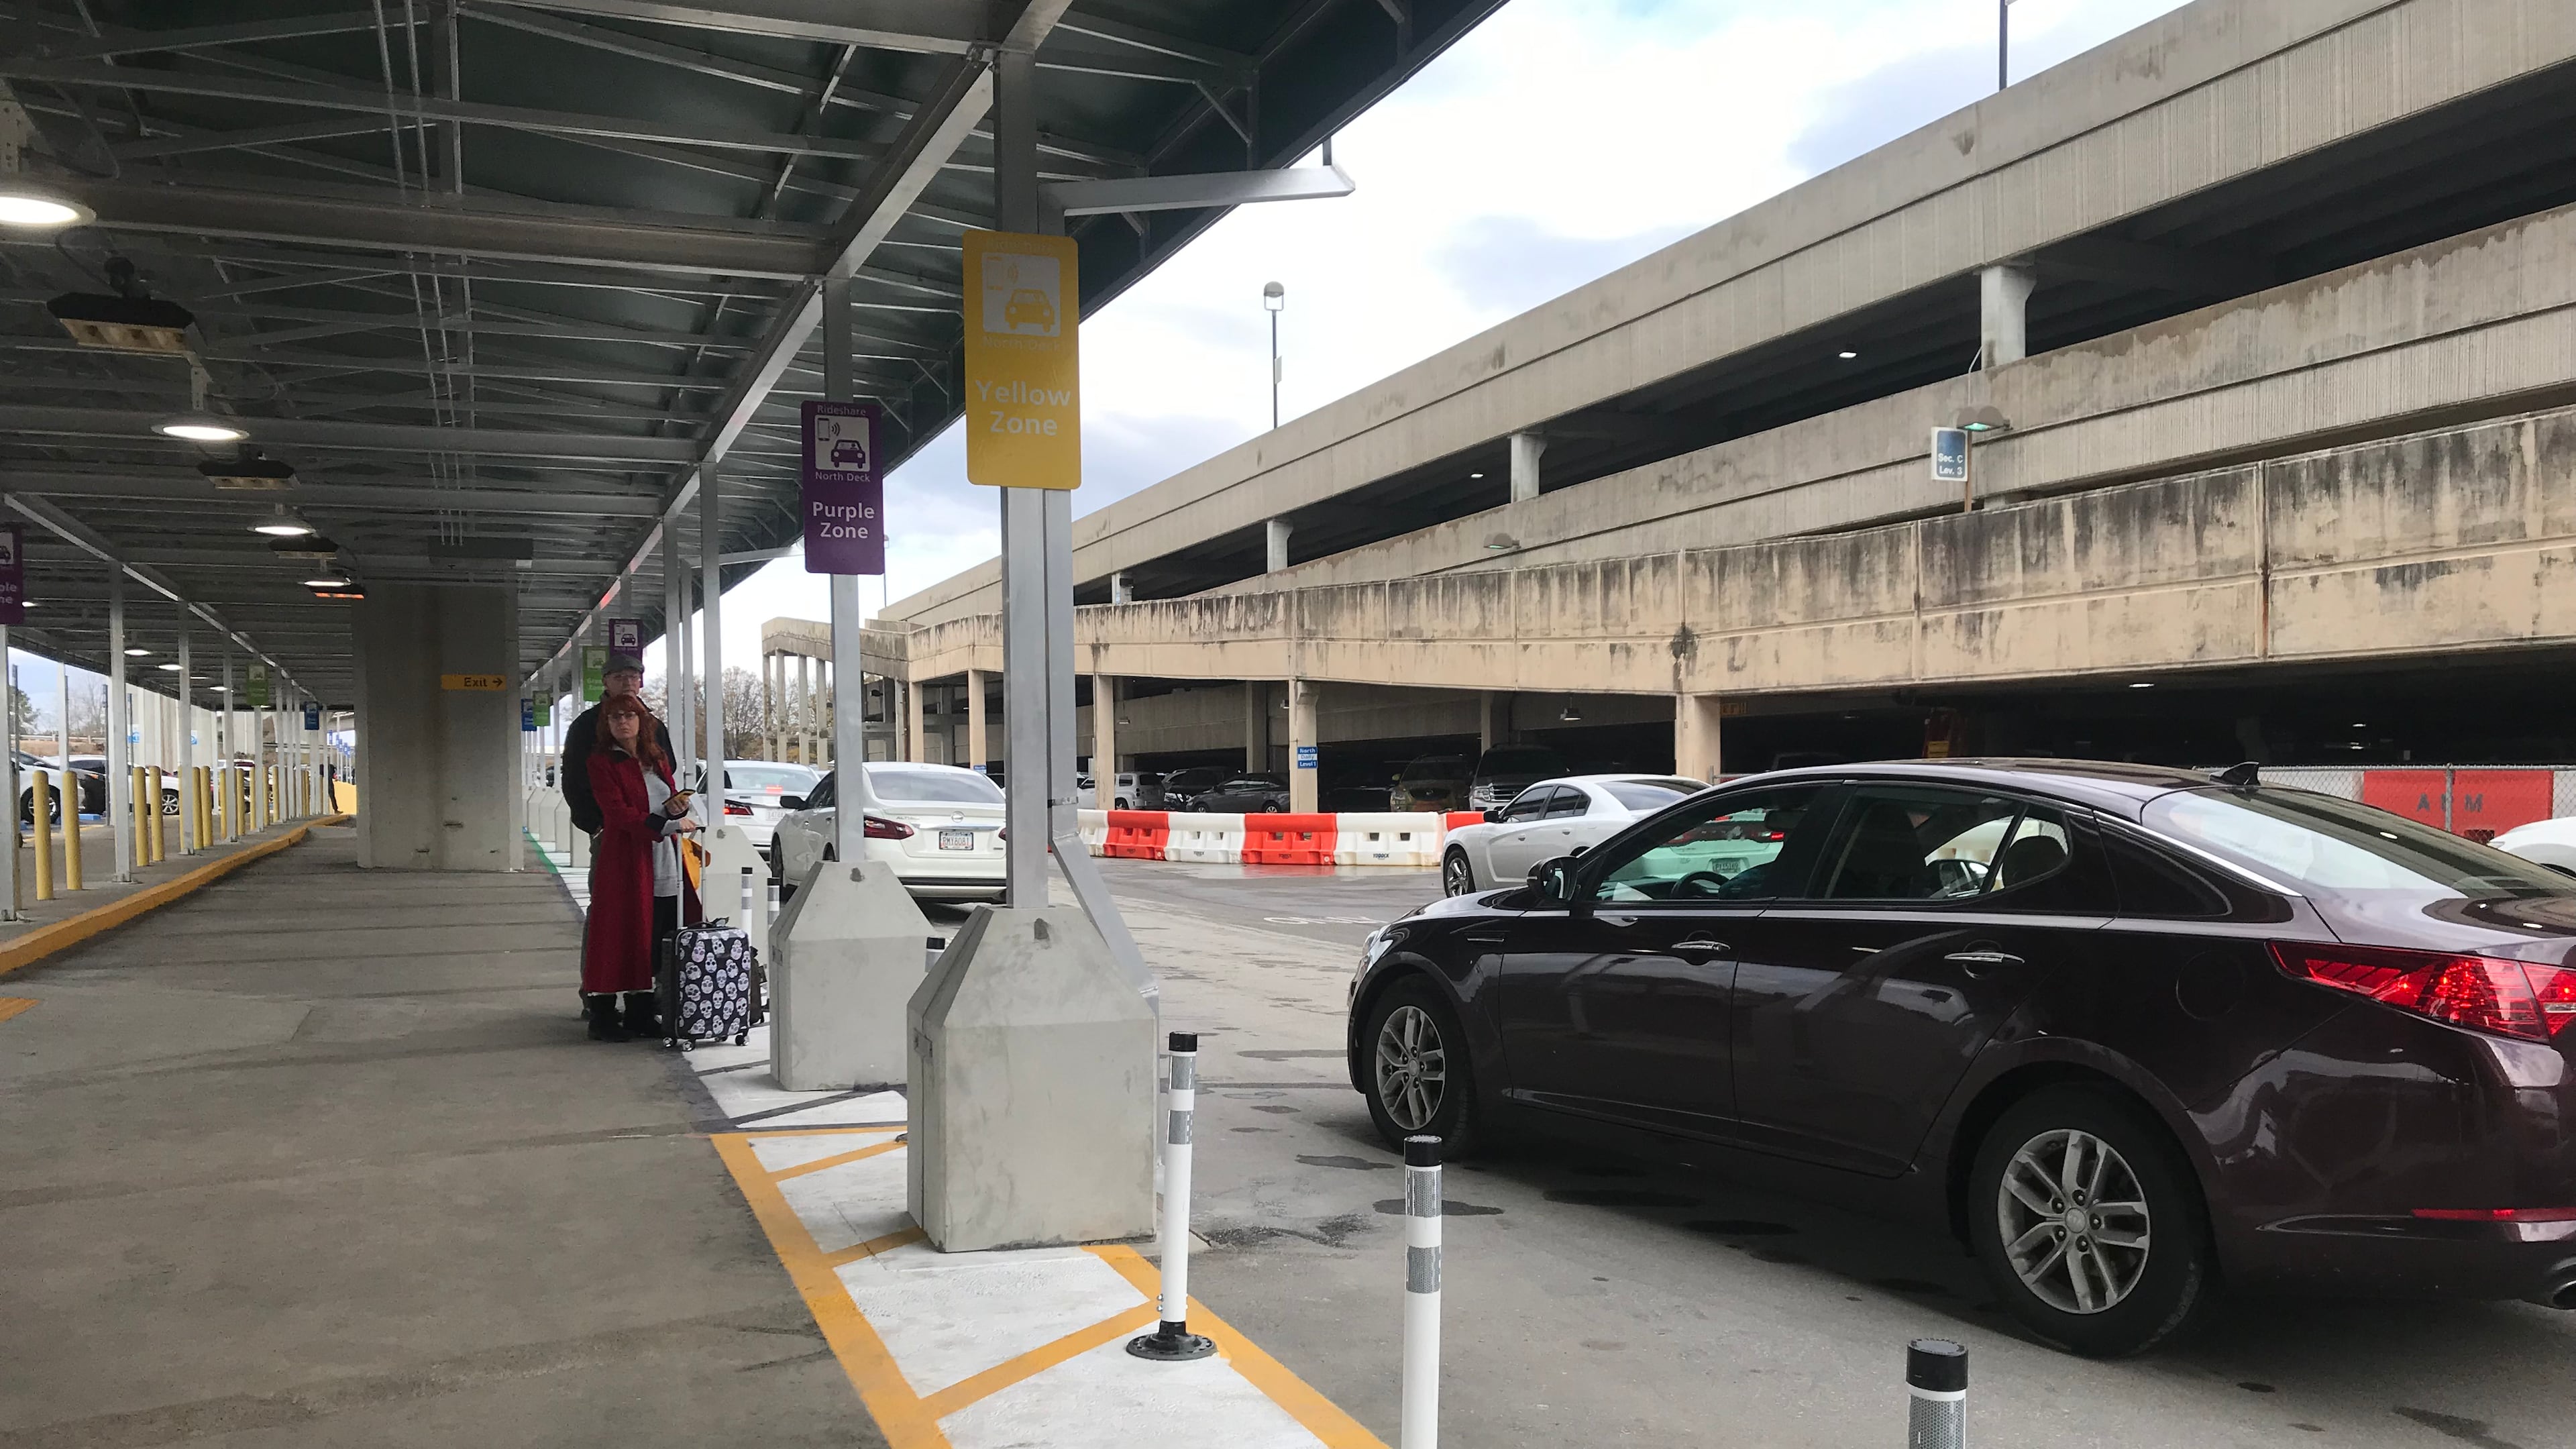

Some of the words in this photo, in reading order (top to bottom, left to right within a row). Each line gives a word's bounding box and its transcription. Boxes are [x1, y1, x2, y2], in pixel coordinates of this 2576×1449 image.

[975, 380, 1071, 407] Yellow
[816, 405, 866, 415] Rideshare
[989, 411, 1058, 436] Zone
[1938, 453, 1955, 463] Sec.
[1957, 454, 1964, 464] C
[1957, 466, 1963, 475] 3
[815, 472, 843, 480] North
[847, 473, 871, 482] Deck
[812, 501, 875, 522] Purple
[820, 523, 868, 539] Zone
[464, 678, 488, 687] Exit
